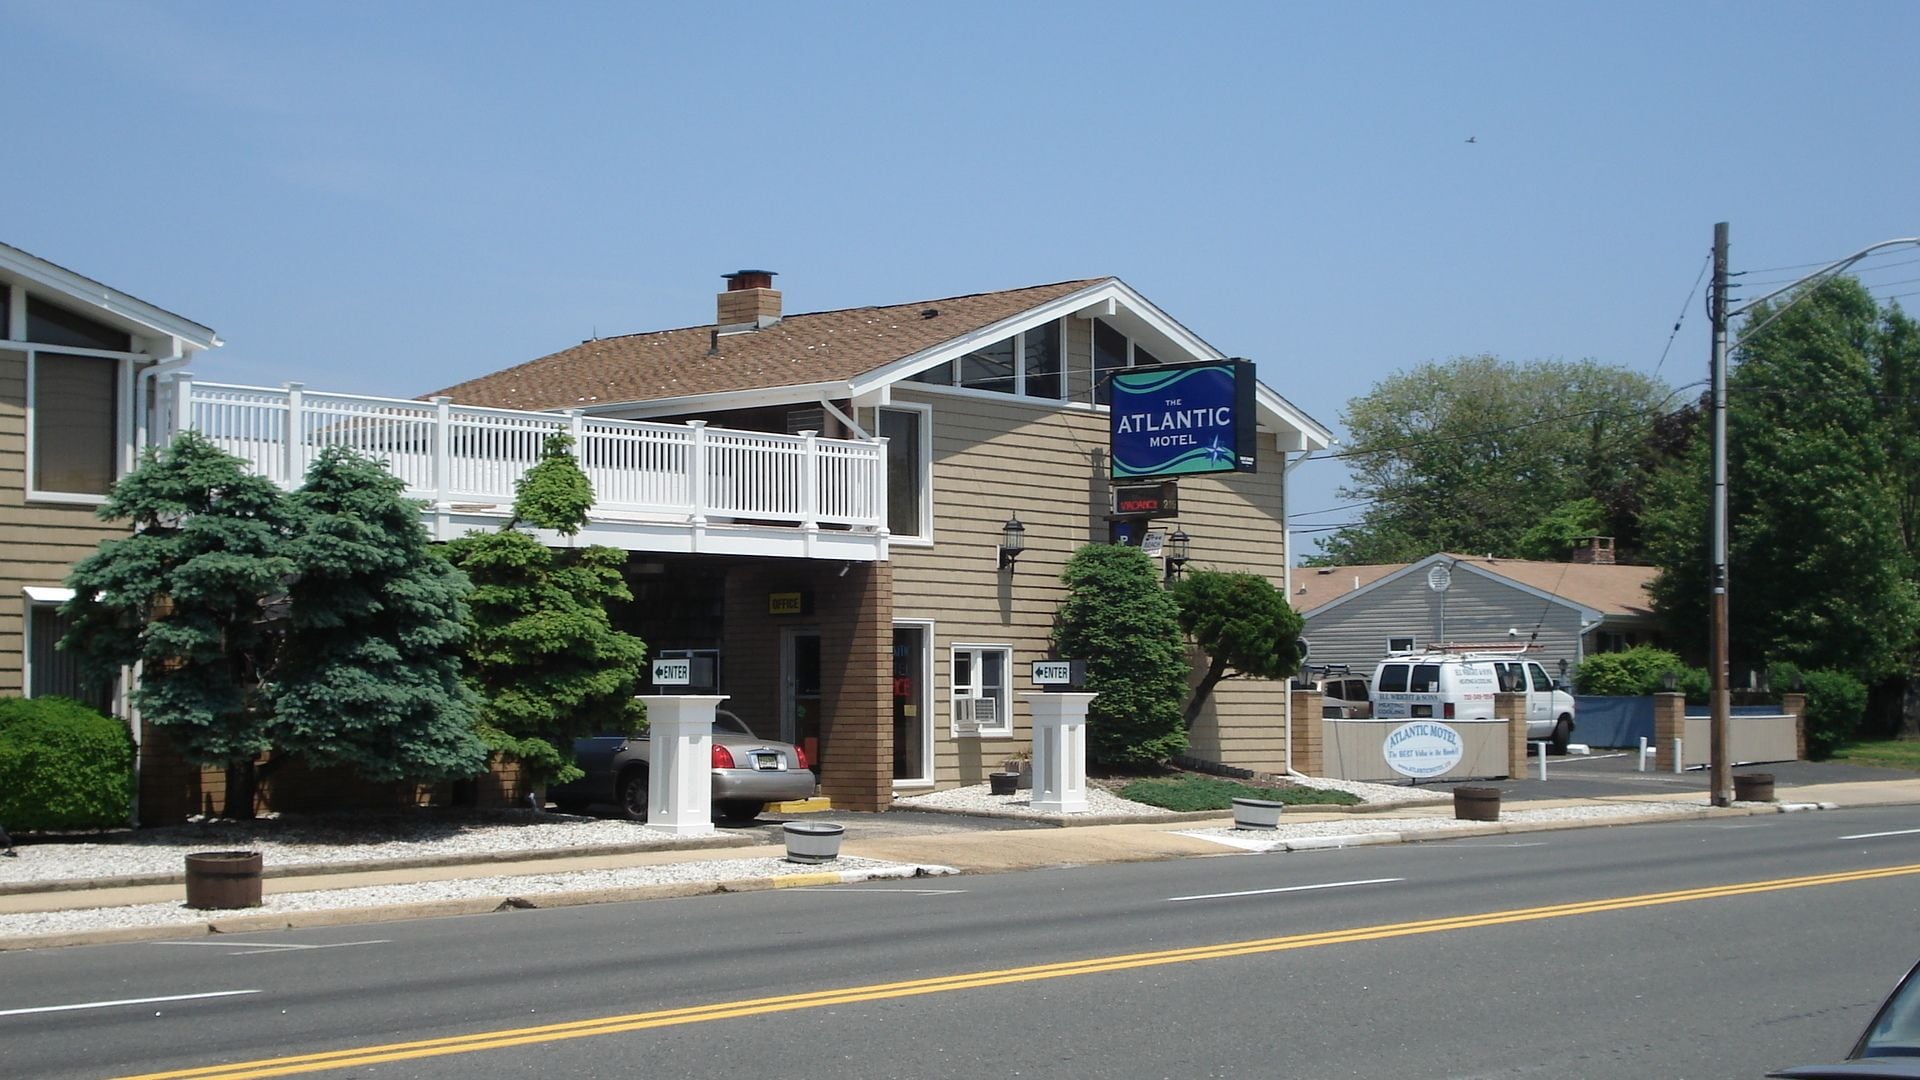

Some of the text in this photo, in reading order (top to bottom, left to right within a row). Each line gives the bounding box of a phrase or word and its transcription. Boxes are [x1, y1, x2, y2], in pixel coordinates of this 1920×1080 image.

[1117, 407, 1230, 434] ATLANTIC
[1150, 434, 1198, 448] MOTEL
[773, 598, 799, 609] OFFICE
[664, 665, 688, 680] ENTER
[1044, 666, 1067, 679] ENTER
[1389, 725, 1457, 749] ATLANTIC MOTEL
